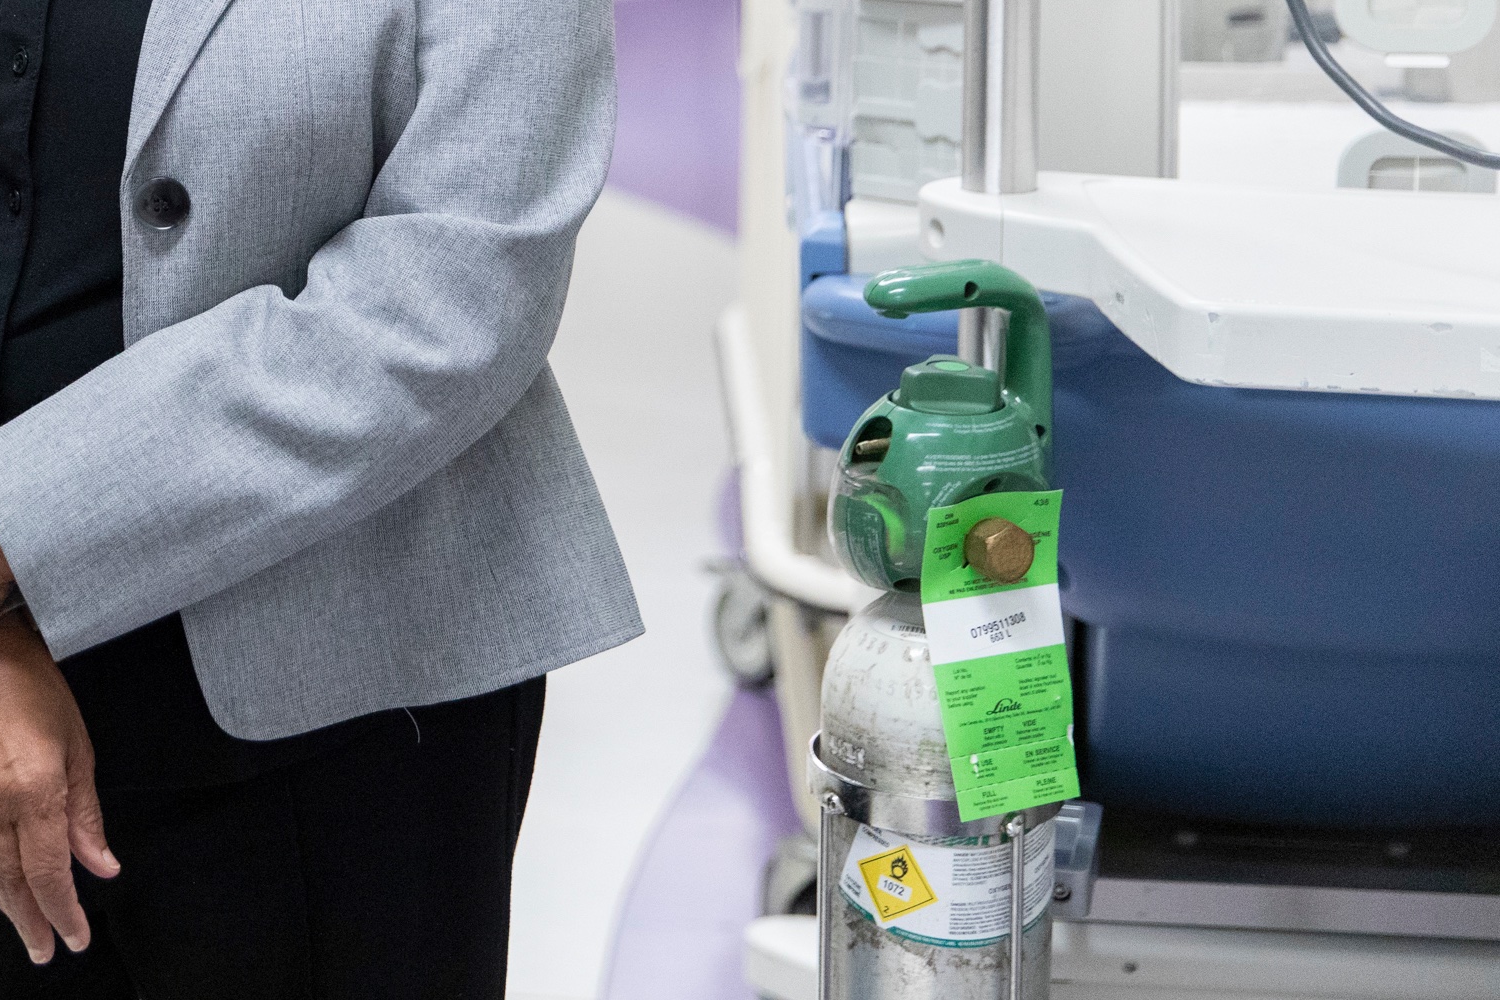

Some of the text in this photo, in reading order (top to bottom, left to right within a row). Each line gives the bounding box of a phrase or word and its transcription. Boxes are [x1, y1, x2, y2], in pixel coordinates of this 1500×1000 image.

[971, 612, 1026, 639] 0799511308
[1006, 630, 1012, 638] L
[987, 698, 1022, 715] Linde
[984, 726, 1004, 735] EMPTY
[884, 880, 905, 896] 1072
[883, 906, 890, 914] 2
